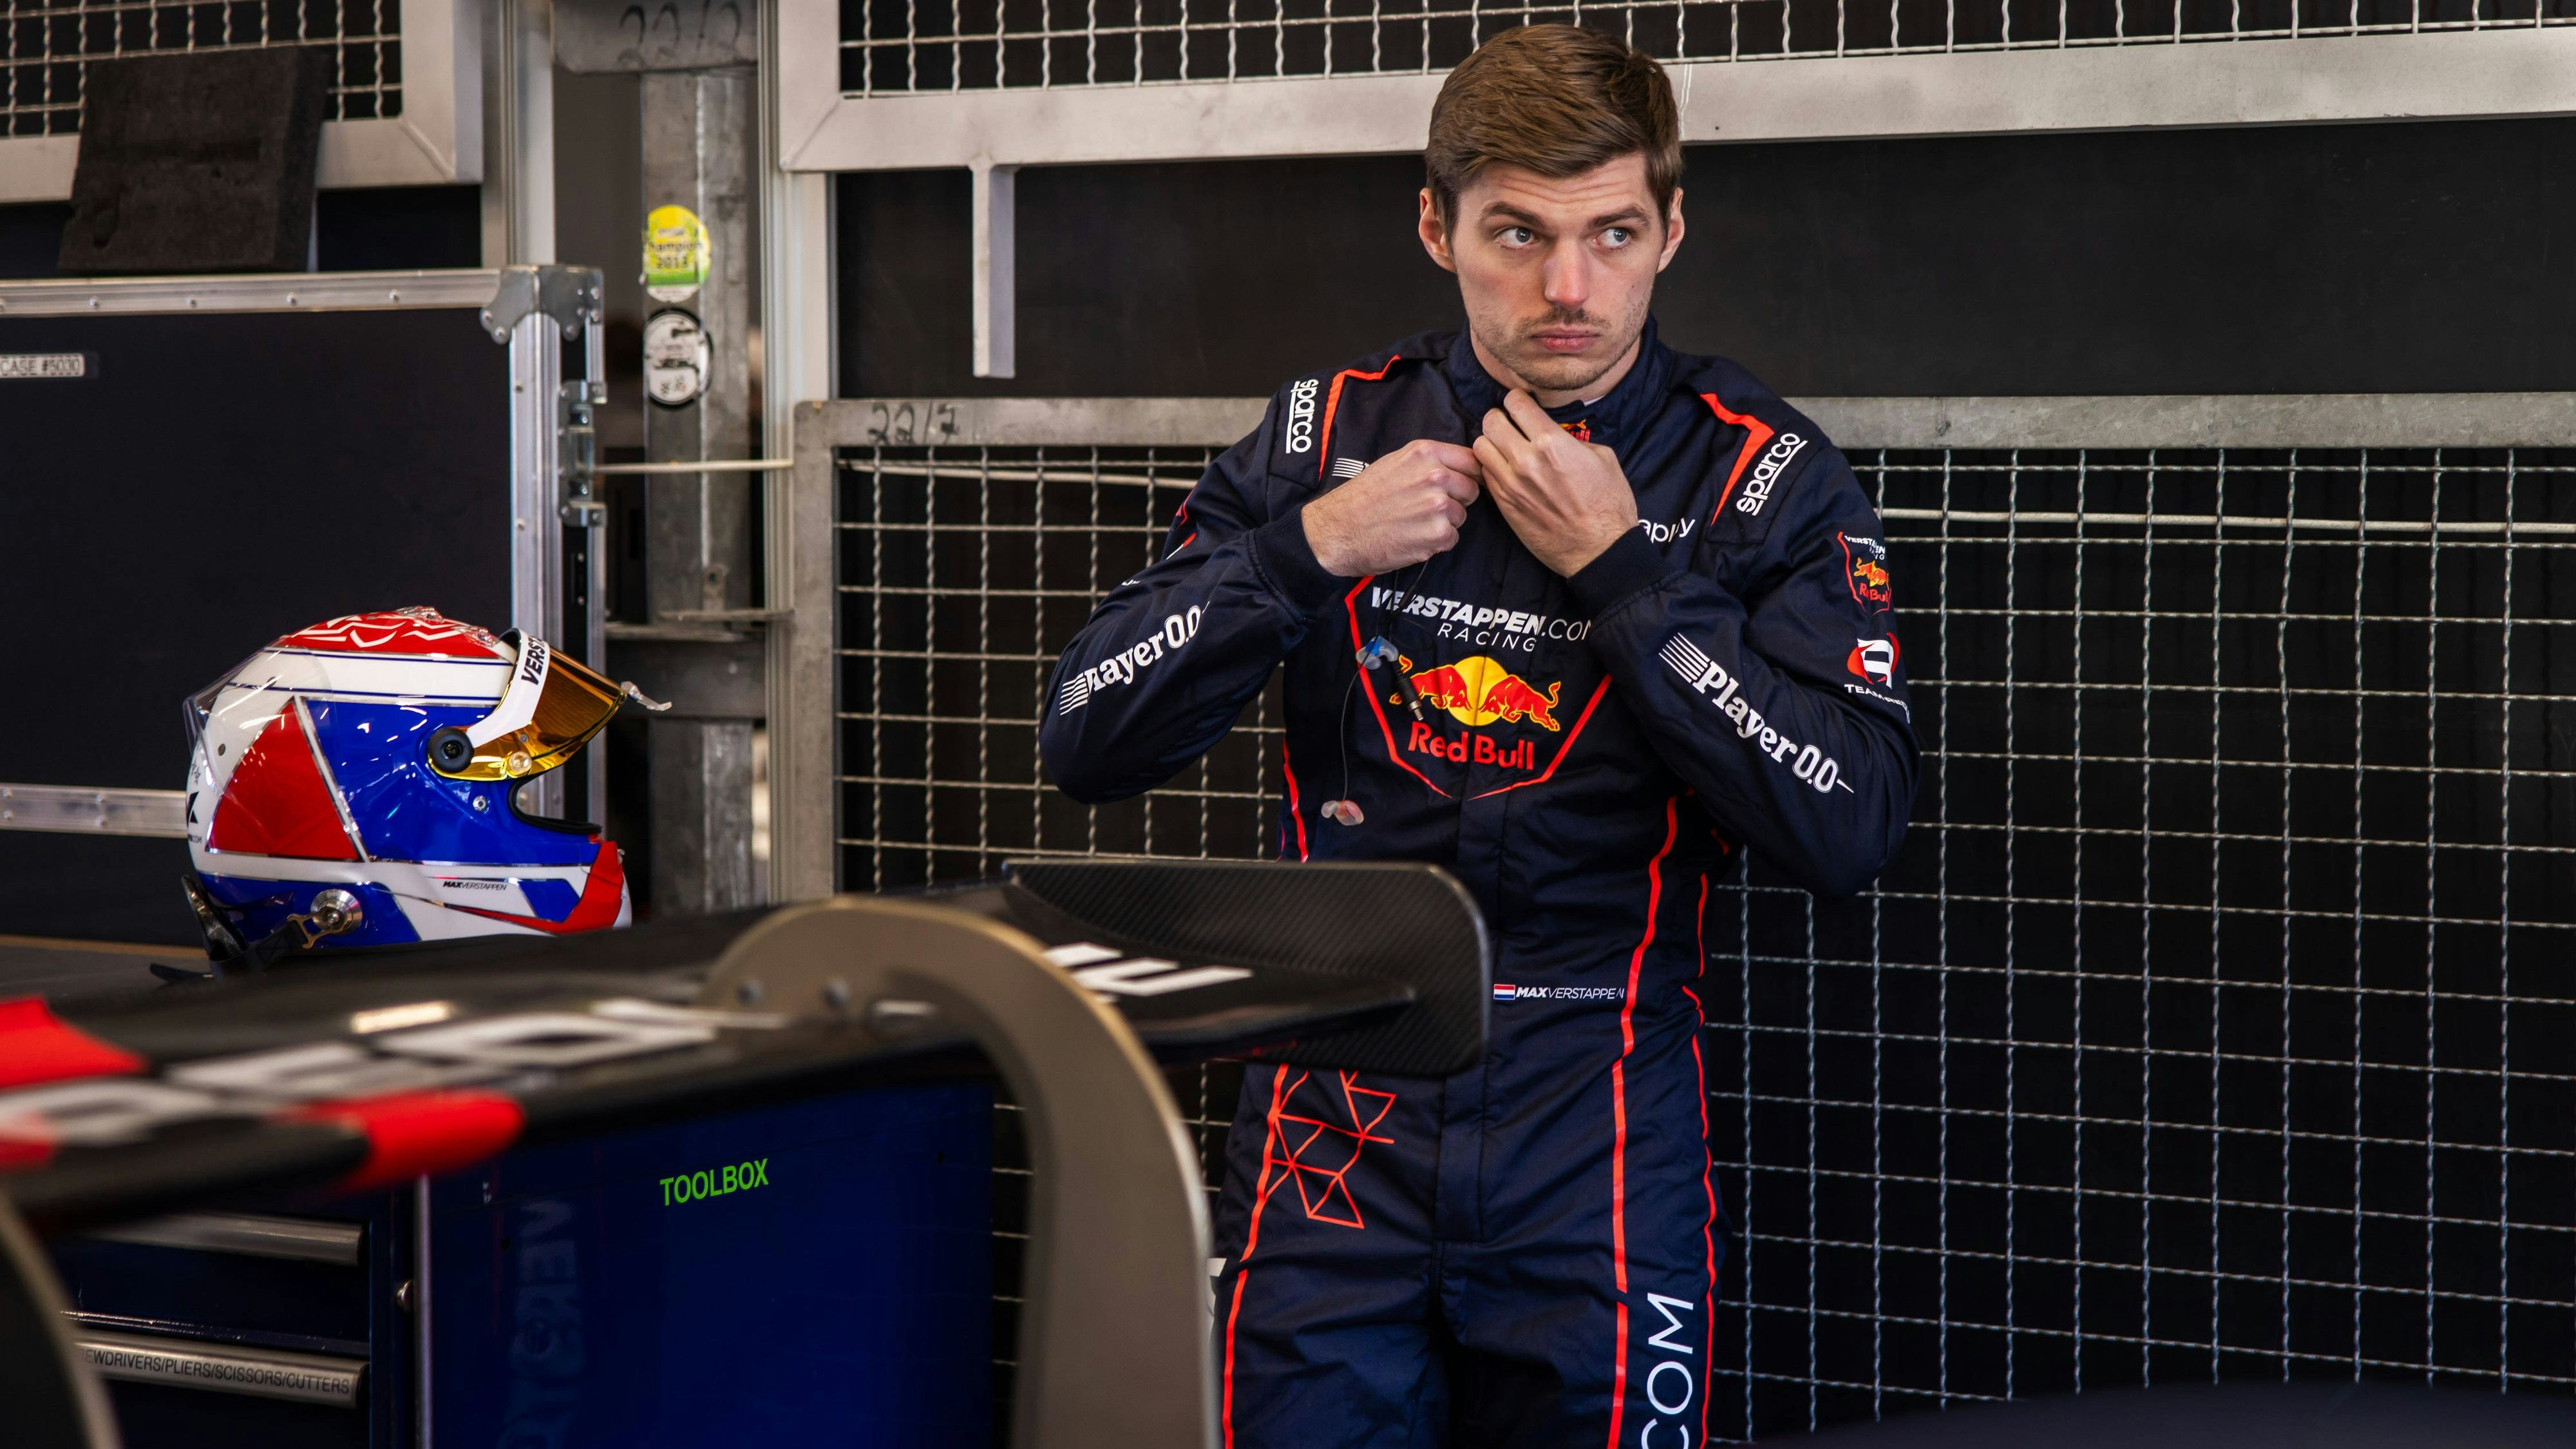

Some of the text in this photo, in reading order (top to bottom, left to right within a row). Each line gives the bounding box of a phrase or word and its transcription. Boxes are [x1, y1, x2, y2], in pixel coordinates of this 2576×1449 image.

[1285, 379, 1320, 453] sparco
[1736, 433, 1808, 516] sparco
[1437, 622, 1537, 652] RACING
[1408, 721, 1535, 771] Red Bull
[659, 1158, 769, 1206] TOOLBOX
